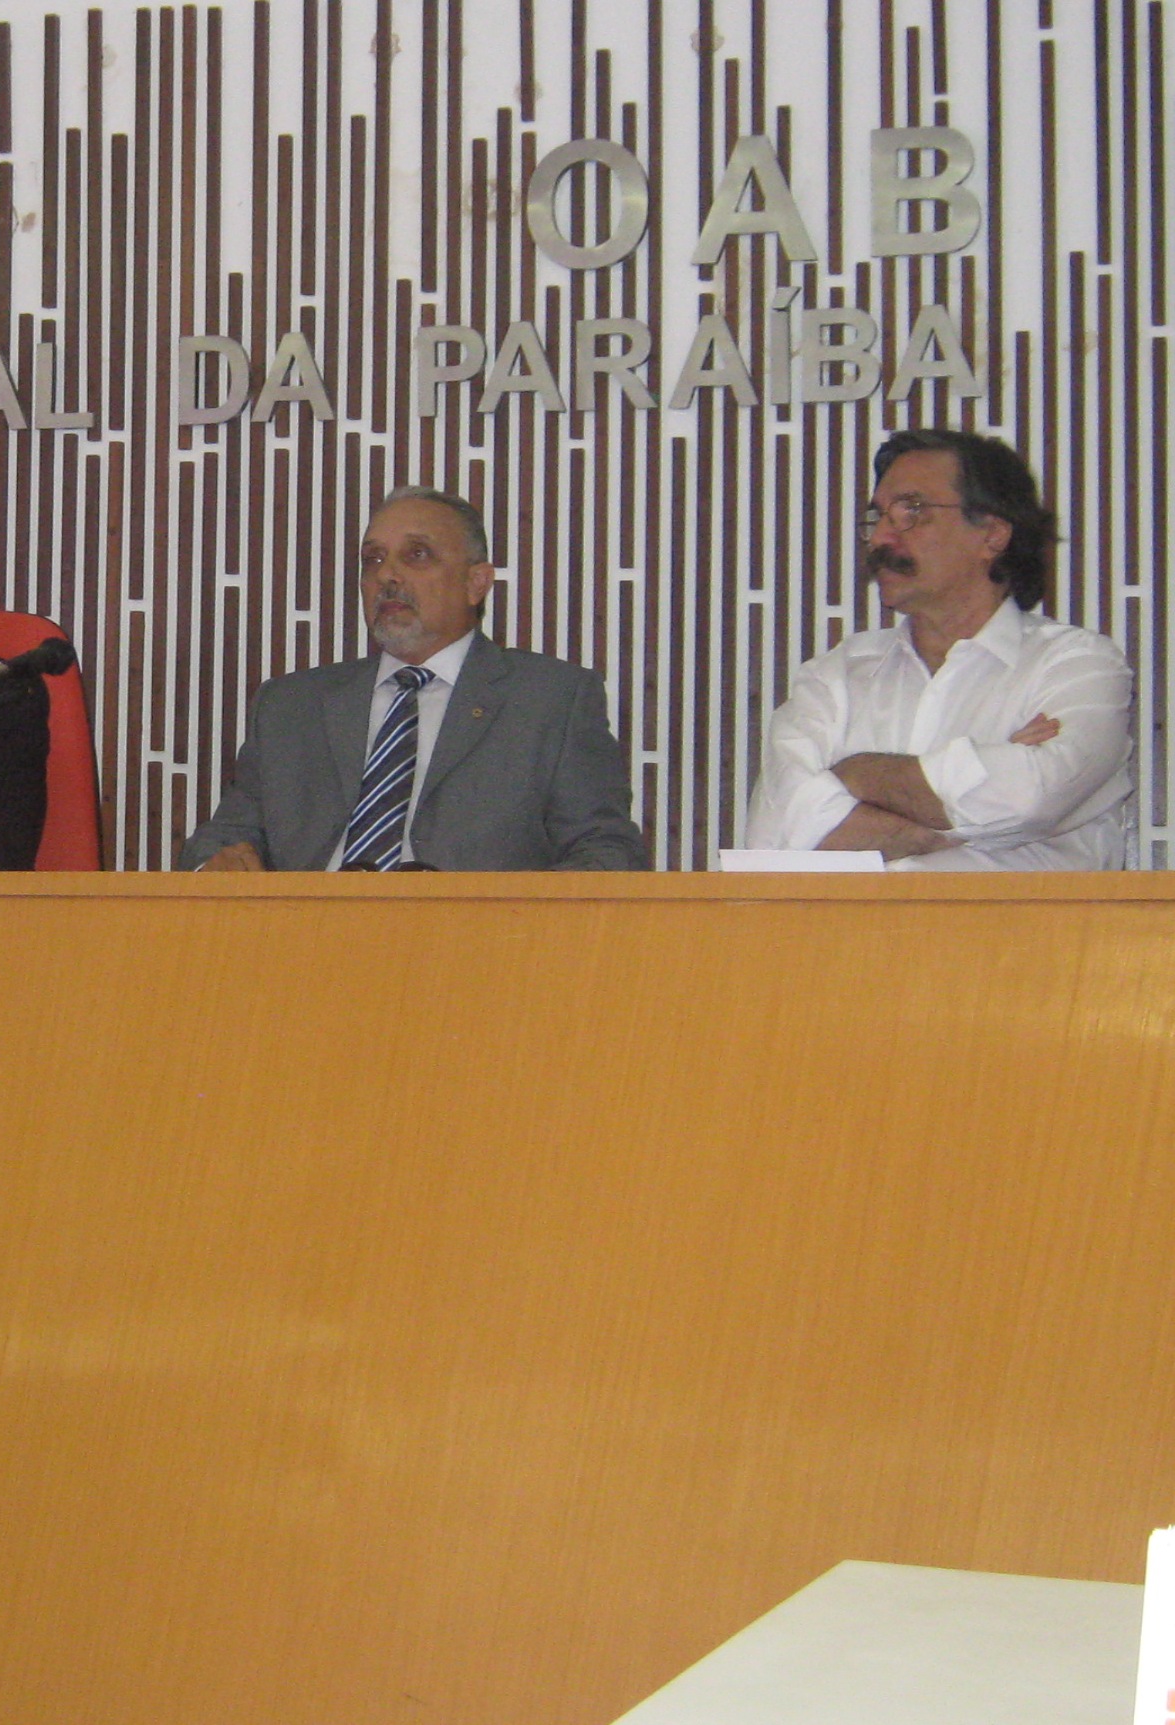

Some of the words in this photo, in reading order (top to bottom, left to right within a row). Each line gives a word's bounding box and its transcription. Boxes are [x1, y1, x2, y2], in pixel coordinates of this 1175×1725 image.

[526, 127, 982, 270] OAB
[178, 332, 334, 426] DA
[417, 286, 982, 418] PARAÍBA
